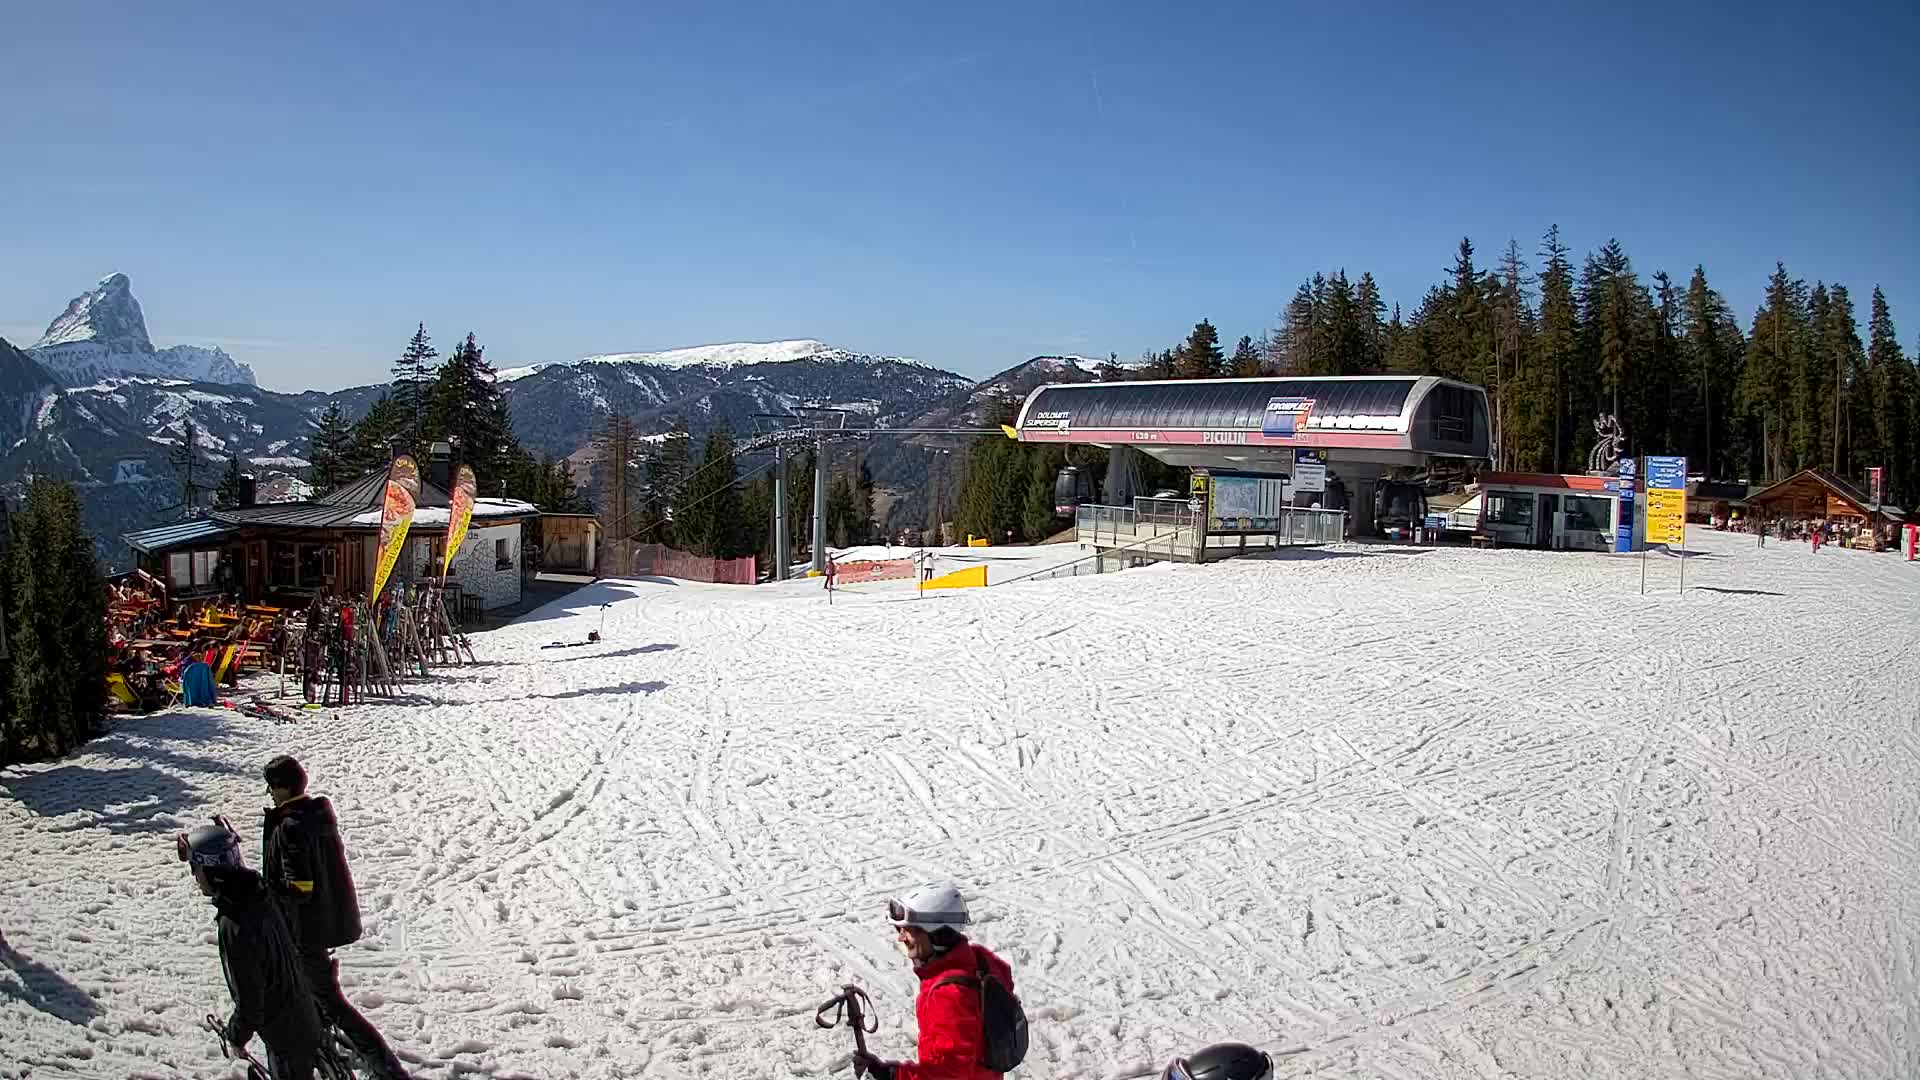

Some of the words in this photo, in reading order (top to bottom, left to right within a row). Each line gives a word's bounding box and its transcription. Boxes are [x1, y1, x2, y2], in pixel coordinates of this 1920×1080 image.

[1268, 402, 1312, 410] KRONPLATZ
[1037, 411, 1069, 419] DOLOMITI
[1203, 432, 1246, 444] PICULIN
